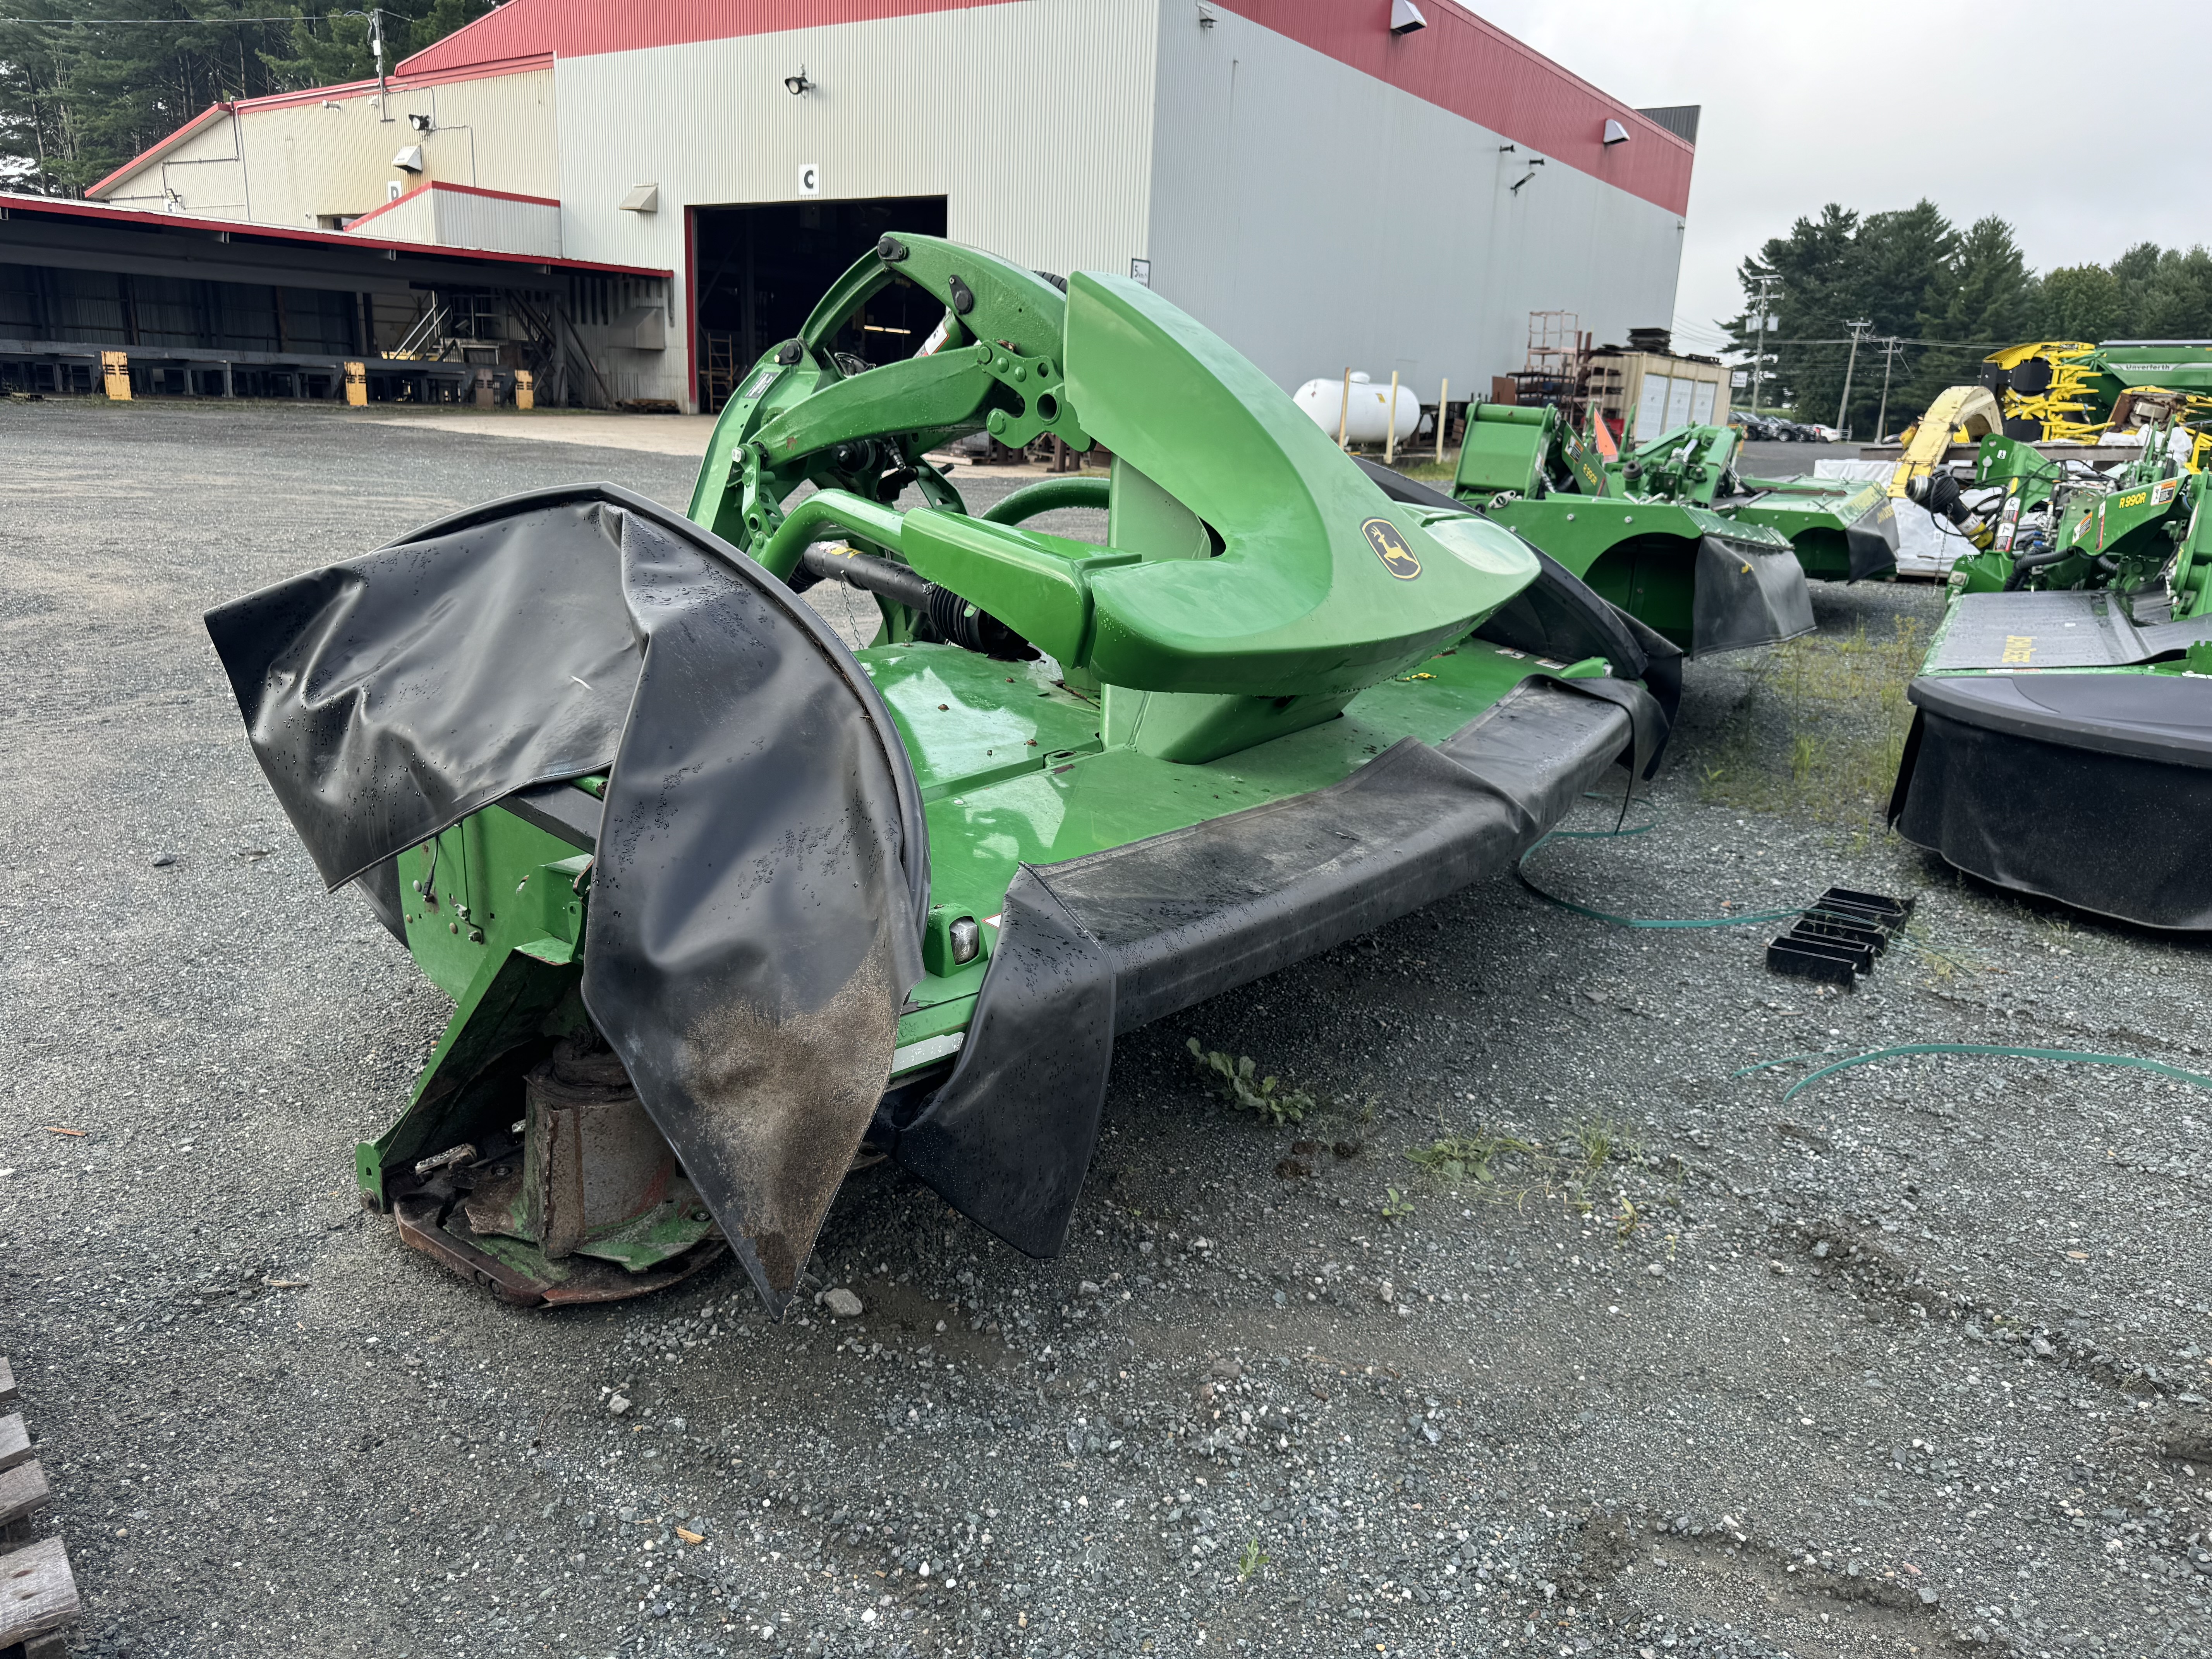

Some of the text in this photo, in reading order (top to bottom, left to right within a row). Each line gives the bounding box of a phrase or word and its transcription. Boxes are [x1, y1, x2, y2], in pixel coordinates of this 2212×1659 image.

[804, 170, 814, 189] C
[390, 186, 399, 201] D
[2119, 492, 2147, 508] R 990R
